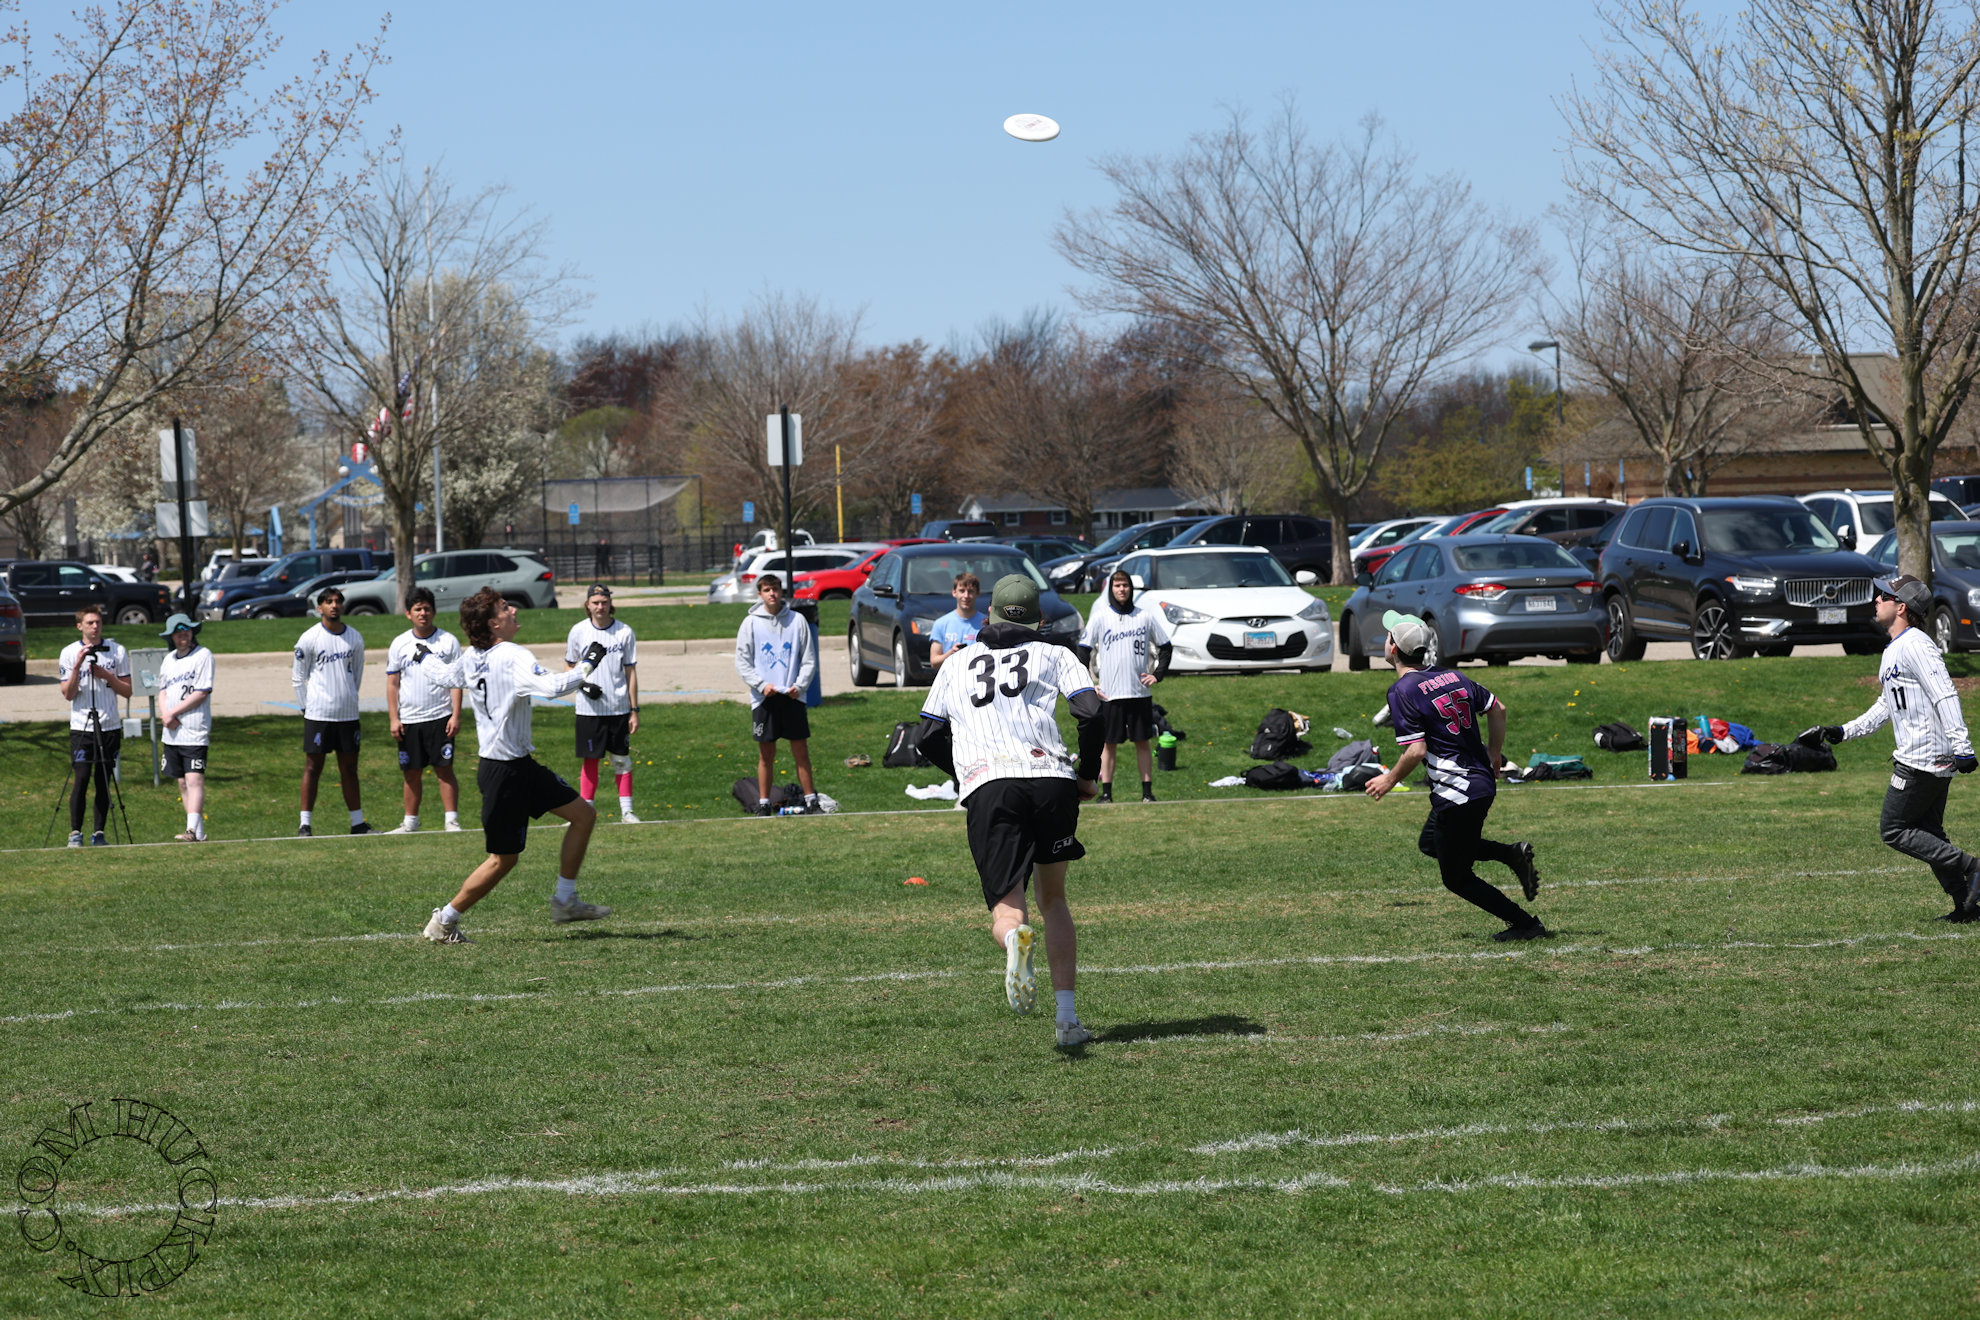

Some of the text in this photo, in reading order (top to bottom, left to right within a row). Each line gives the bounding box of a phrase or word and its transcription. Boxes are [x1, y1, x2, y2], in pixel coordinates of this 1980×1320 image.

[1102, 625, 1147, 651] Gnomes
[1133, 640, 1146, 656] 99
[968, 649, 1030, 708] 33
[1418, 672, 1460, 695] FISSION
[1431, 687, 1472, 735] 55
[1891, 686, 1907, 711] 11
[191, 759, 206, 770] IS
